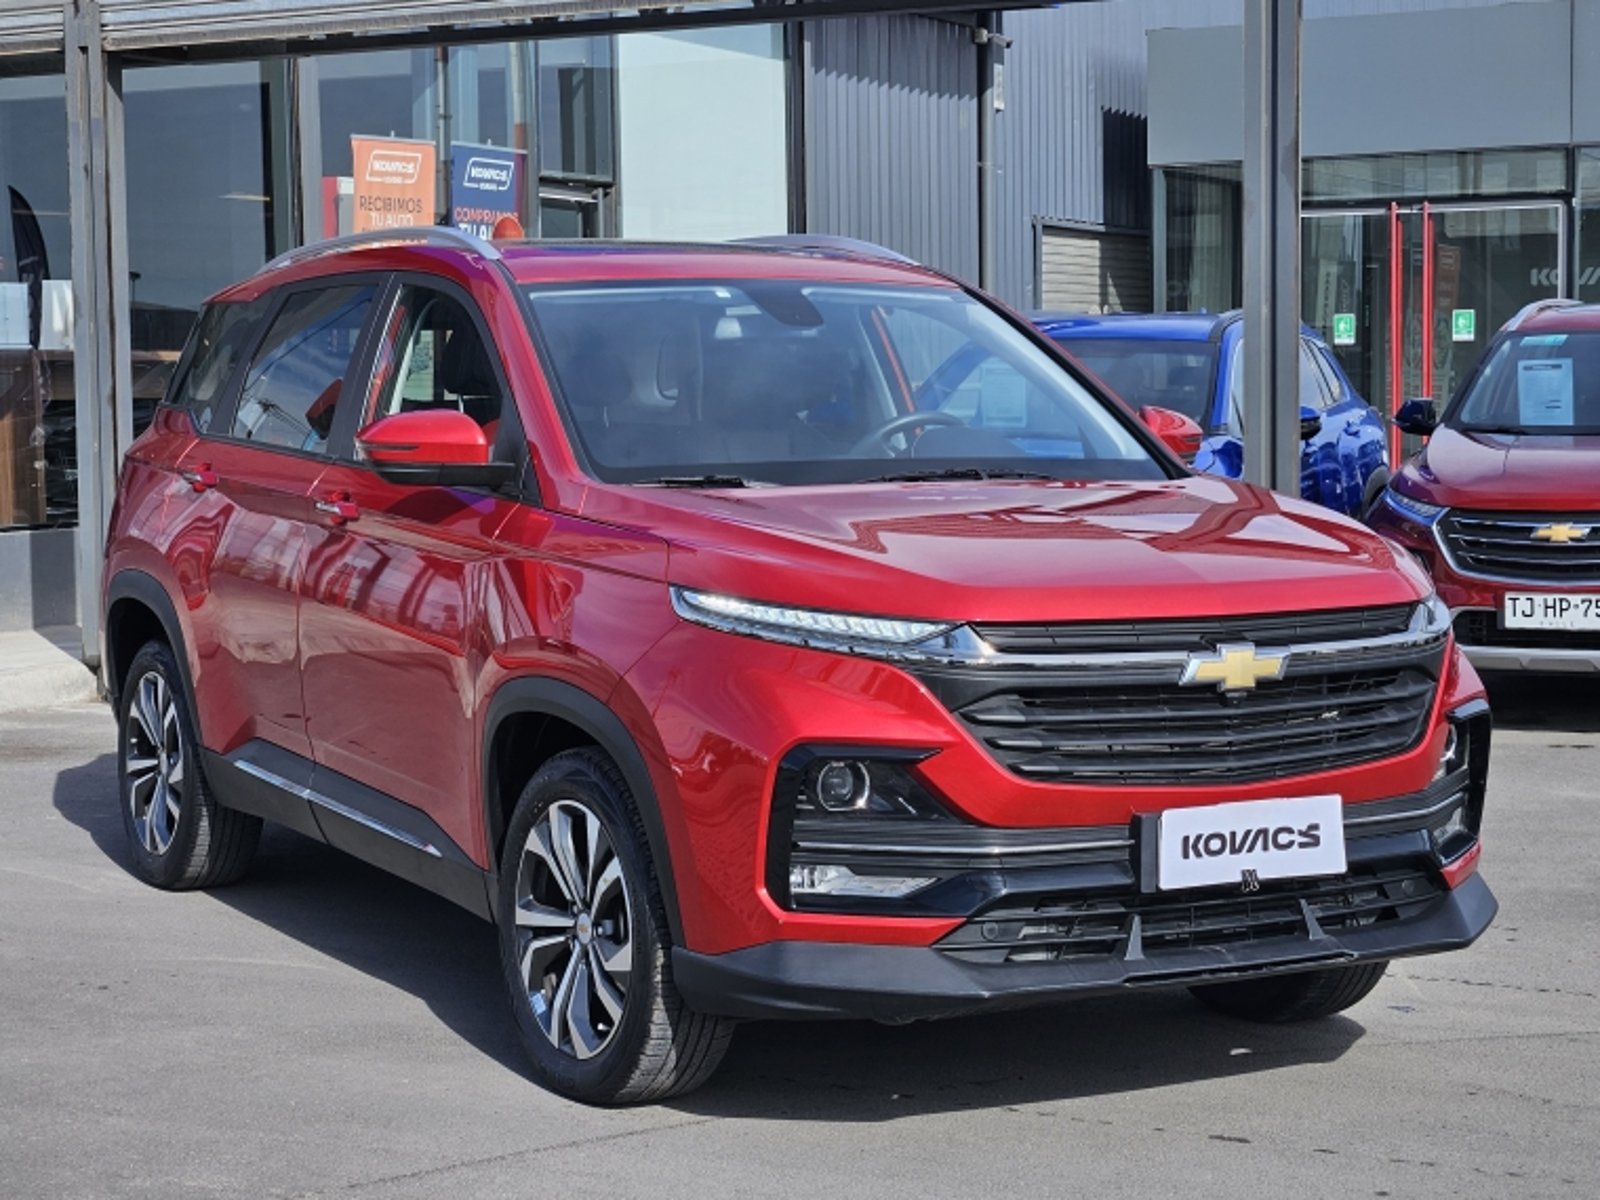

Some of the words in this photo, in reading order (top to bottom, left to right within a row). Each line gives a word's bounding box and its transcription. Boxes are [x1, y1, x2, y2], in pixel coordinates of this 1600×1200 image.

[360, 195, 423, 213] RECIBIMOS
[455, 207, 519, 224] COMPRA
[1182, 823, 1321, 859] KOVACS
